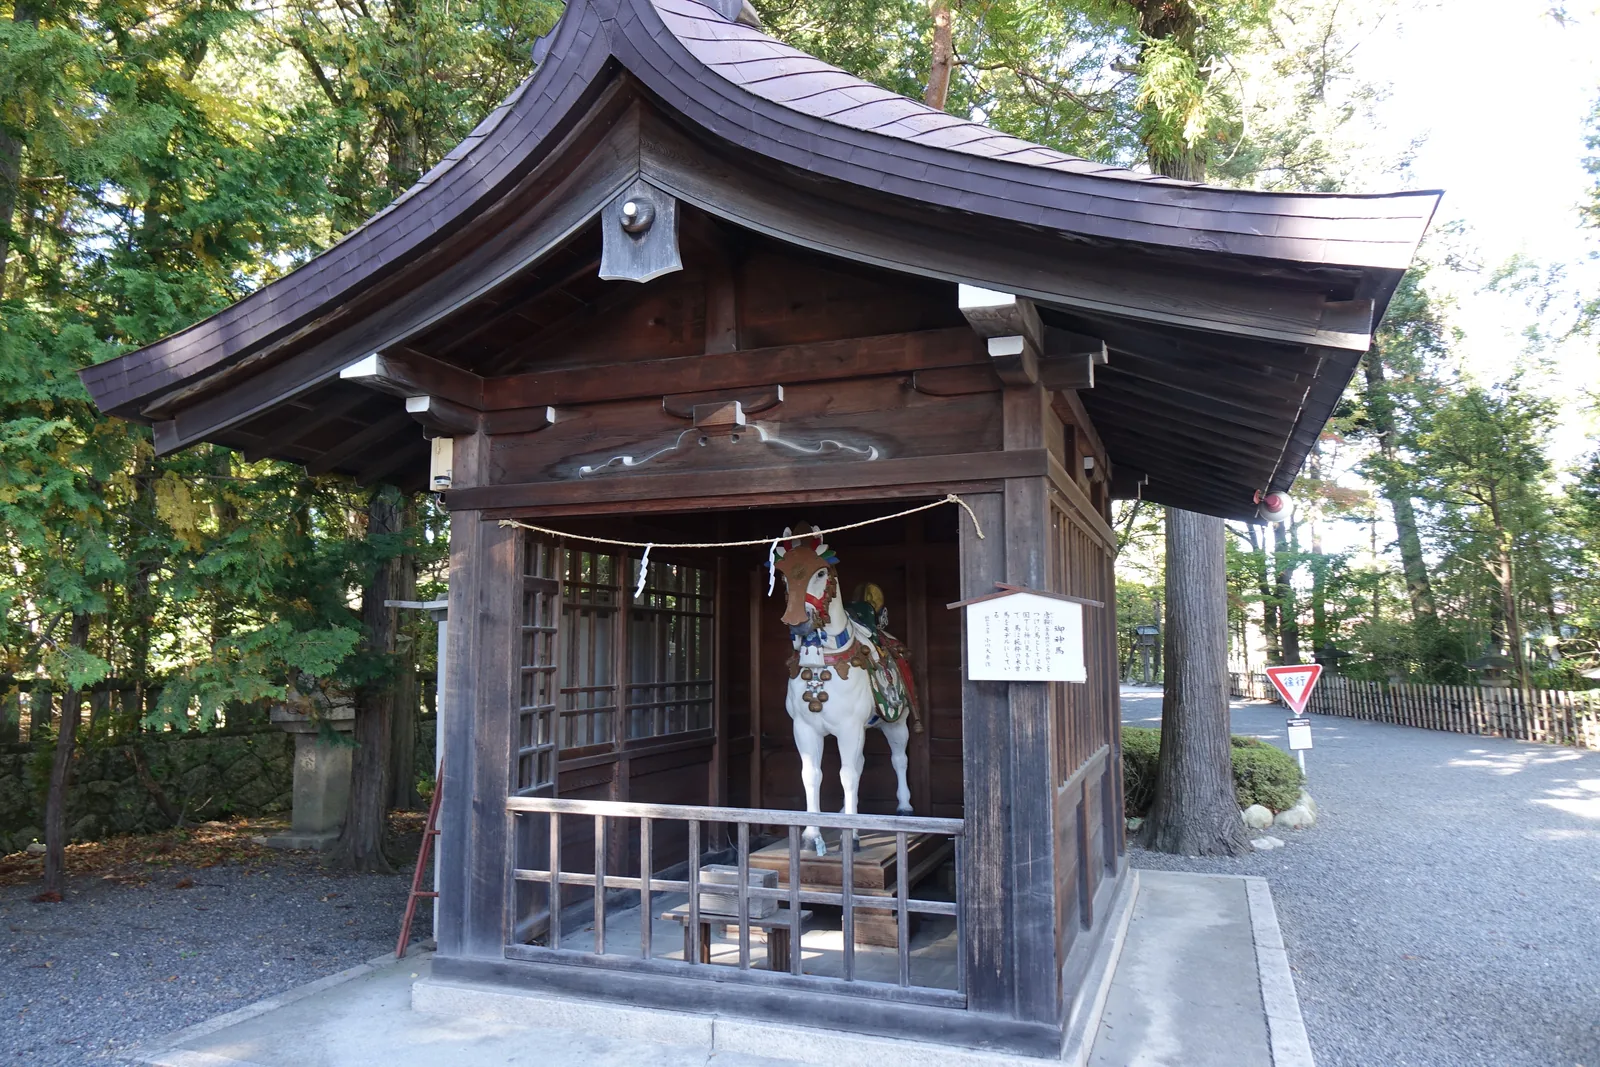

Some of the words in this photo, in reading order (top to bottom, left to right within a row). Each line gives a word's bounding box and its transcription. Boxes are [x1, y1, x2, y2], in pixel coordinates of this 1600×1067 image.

[1054, 624, 1066, 655] 御神馬
[1284, 675, 1306, 687] 徐行
